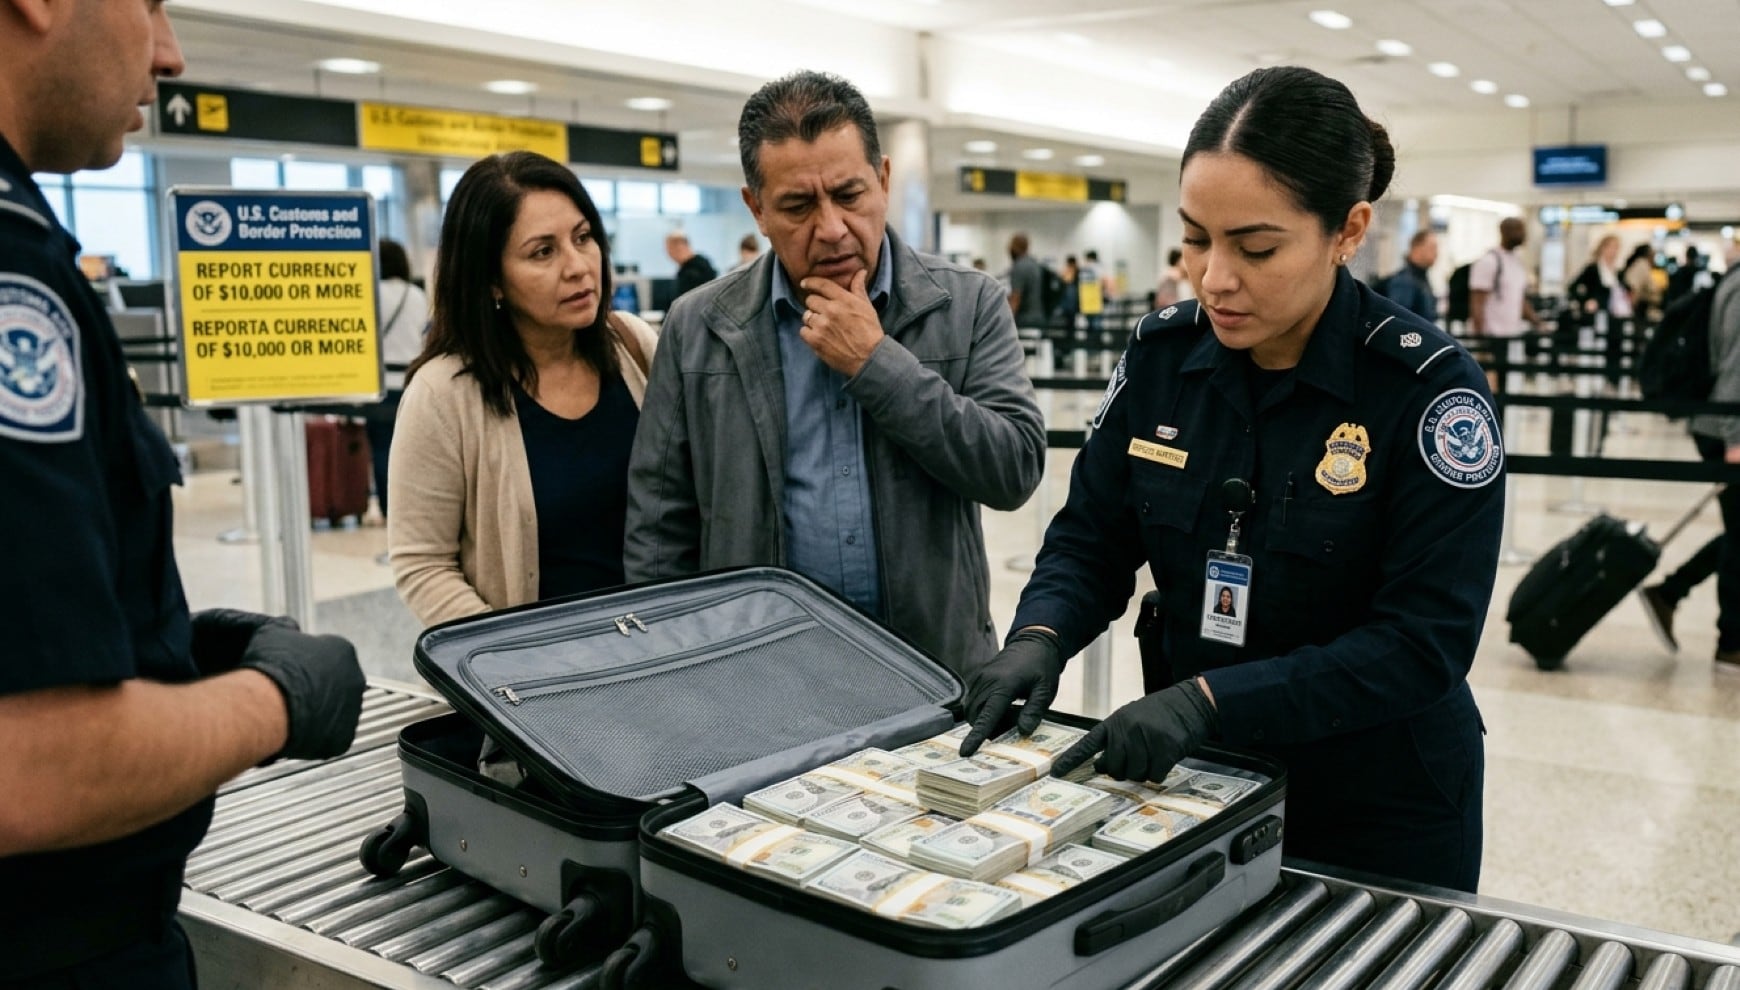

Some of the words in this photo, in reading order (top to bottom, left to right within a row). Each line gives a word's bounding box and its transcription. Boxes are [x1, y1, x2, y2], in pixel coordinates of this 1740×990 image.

[237, 205, 265, 222] U.S.
[269, 206, 329, 222] Customs
[332, 207, 358, 222] and
[238, 224, 287, 239] Border
[290, 224, 362, 239] Protection
[196, 262, 263, 279] REPORT
[269, 262, 357, 278] CURRENCY
[193, 285, 214, 301] OF
[288, 284, 311, 300] OR
[316, 284, 363, 299] MORE
[193, 319, 269, 336] REPORTA
[274, 318, 367, 334] CURRENCIA
[196, 342, 218, 358] OF
[223, 341, 286, 359] $10,000
[291, 340, 313, 356] OR
[318, 339, 366, 355] MORE
